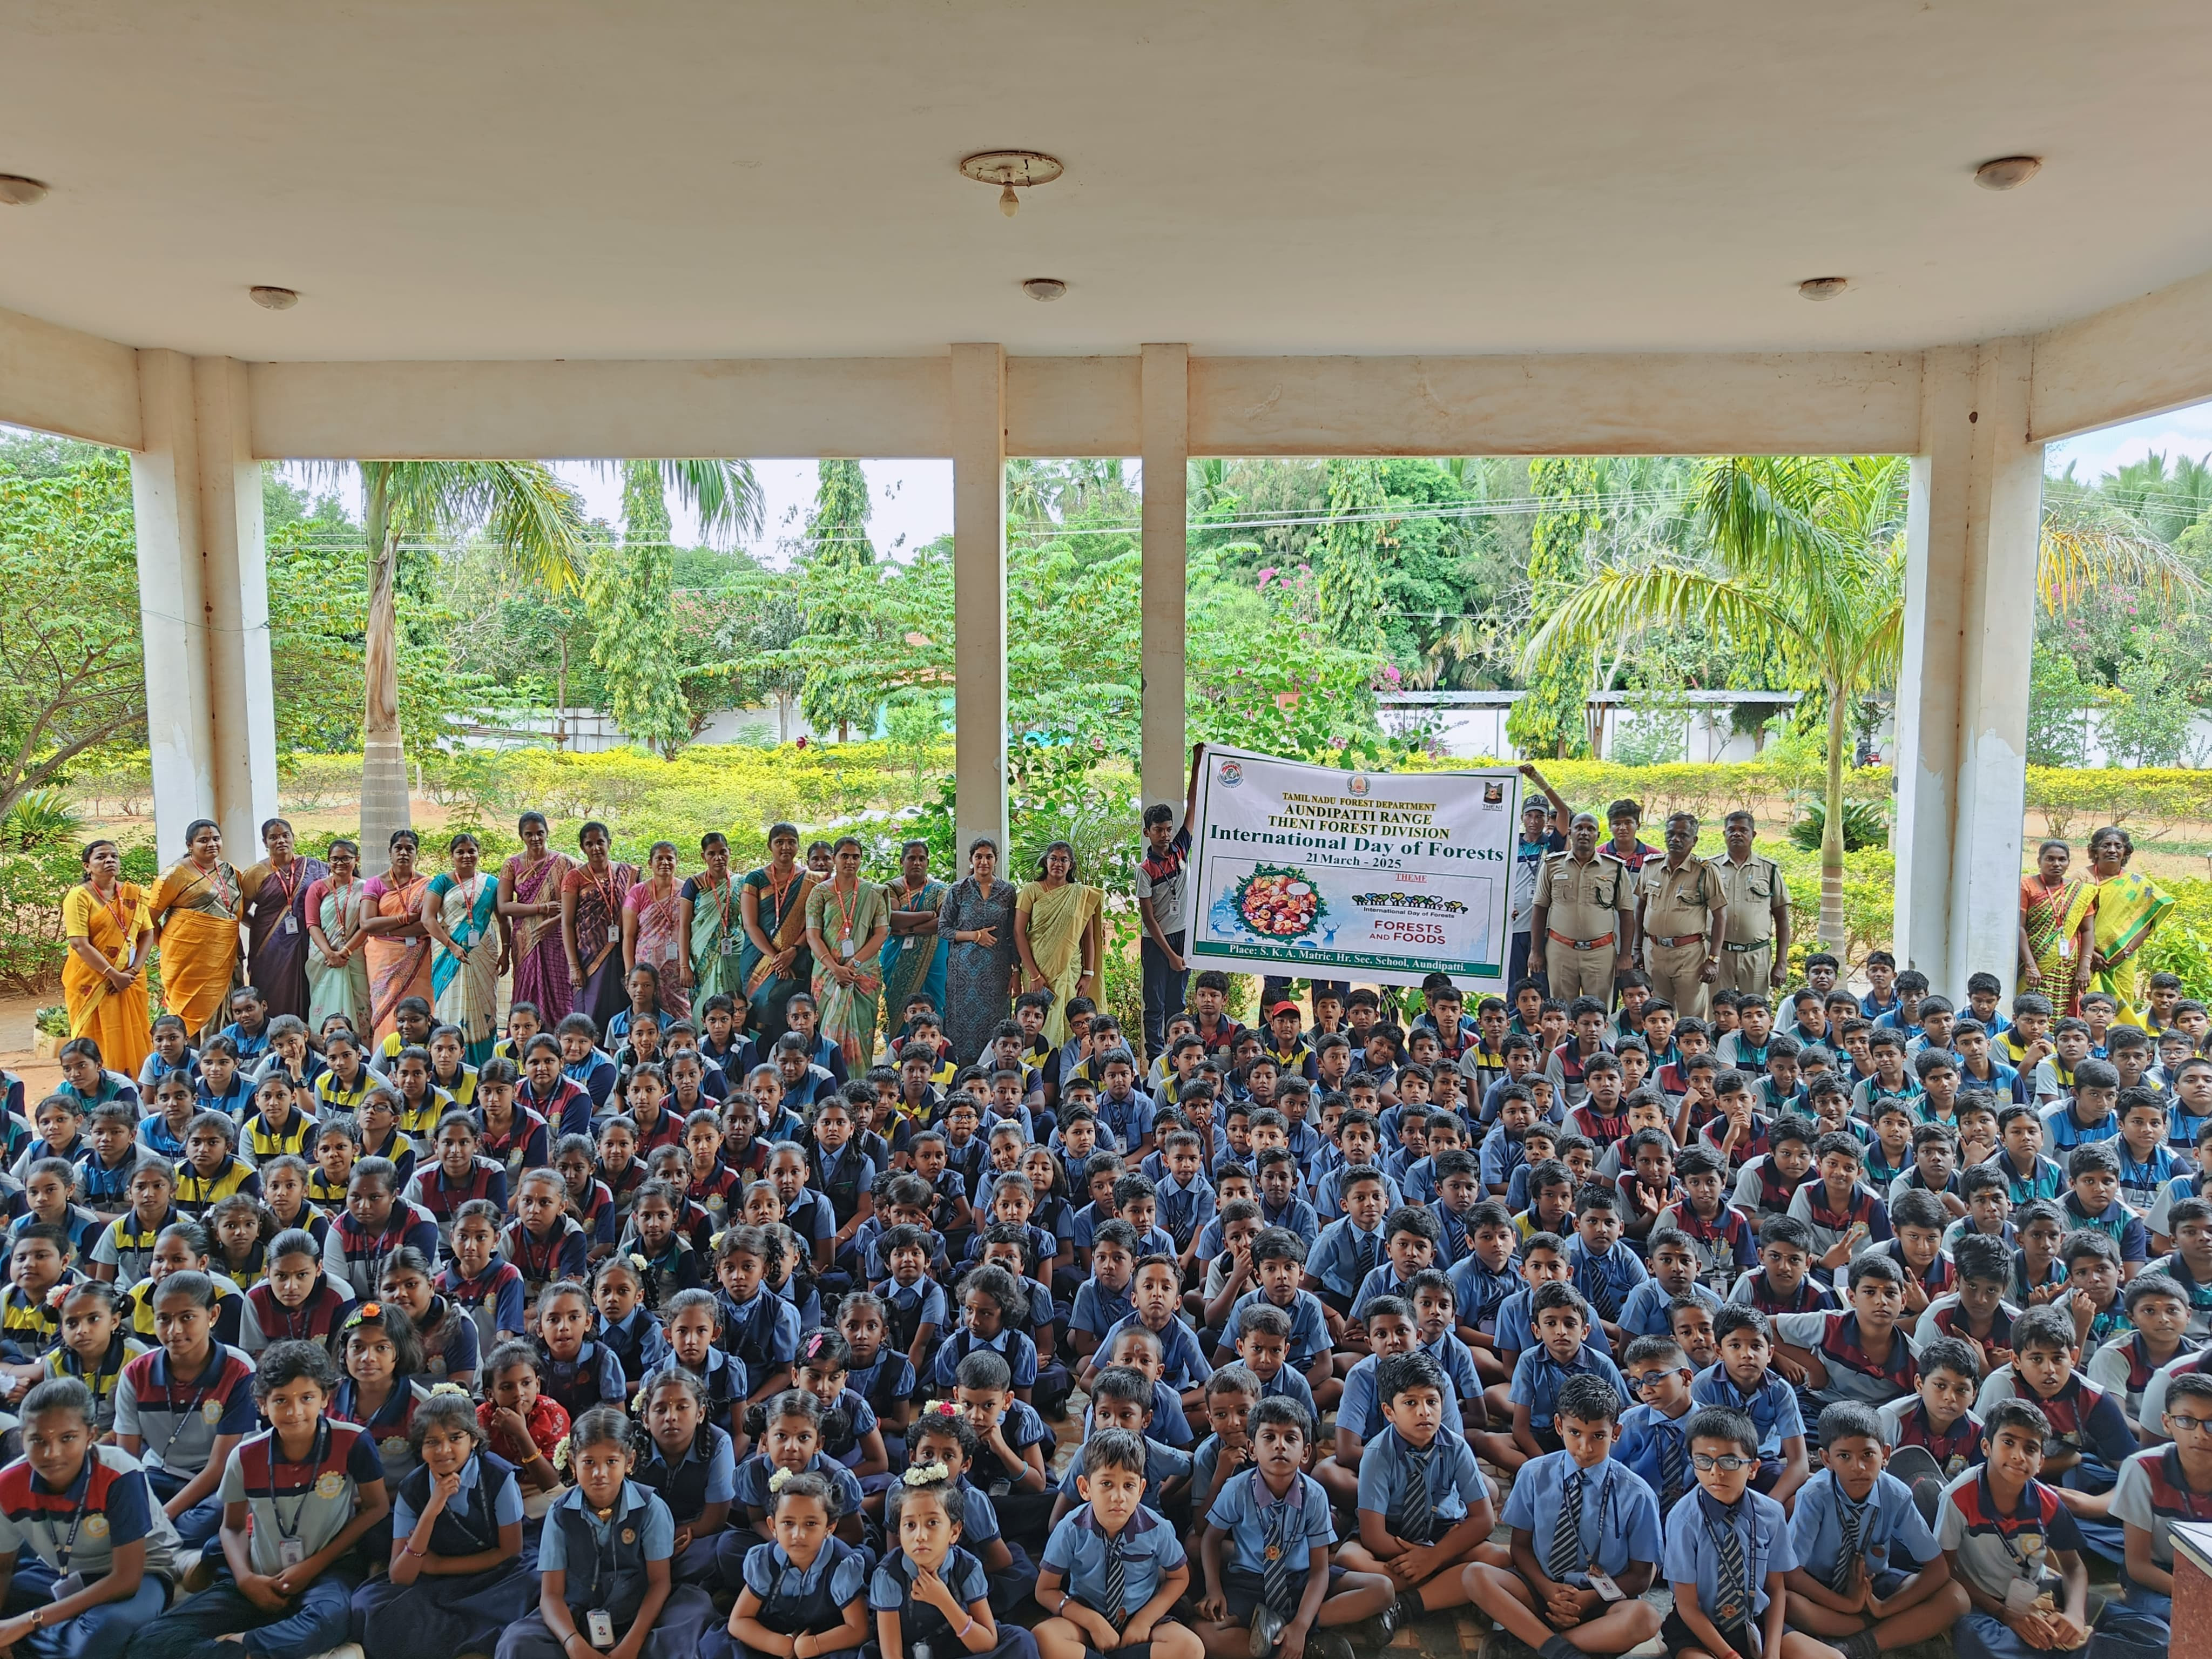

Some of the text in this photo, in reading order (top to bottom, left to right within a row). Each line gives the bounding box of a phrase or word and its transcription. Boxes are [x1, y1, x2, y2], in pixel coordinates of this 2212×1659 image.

[1282, 792, 1437, 811] TAMIL NADU FOREST DEPARTMENT
[1527, 795, 1543, 804] BOY
[1284, 804, 1432, 825] AUNDIPATTI RANGE
[1268, 815, 1451, 840] THENI FOREST DIVISION
[1209, 824, 1504, 862] International Day of Forests
[1306, 852, 1319, 862] 21
[1320, 853, 1360, 866] March
[1372, 858, 1402, 869] 2025
[1395, 873, 1427, 882] THEME
[1363, 907, 1406, 915] International
[1374, 920, 1443, 934] FORESTS
[1393, 932, 1446, 945] FOODS
[1229, 944, 1466, 972] Place: S. K. A. Matric. Hr. Sec. School, Aundipatti.
